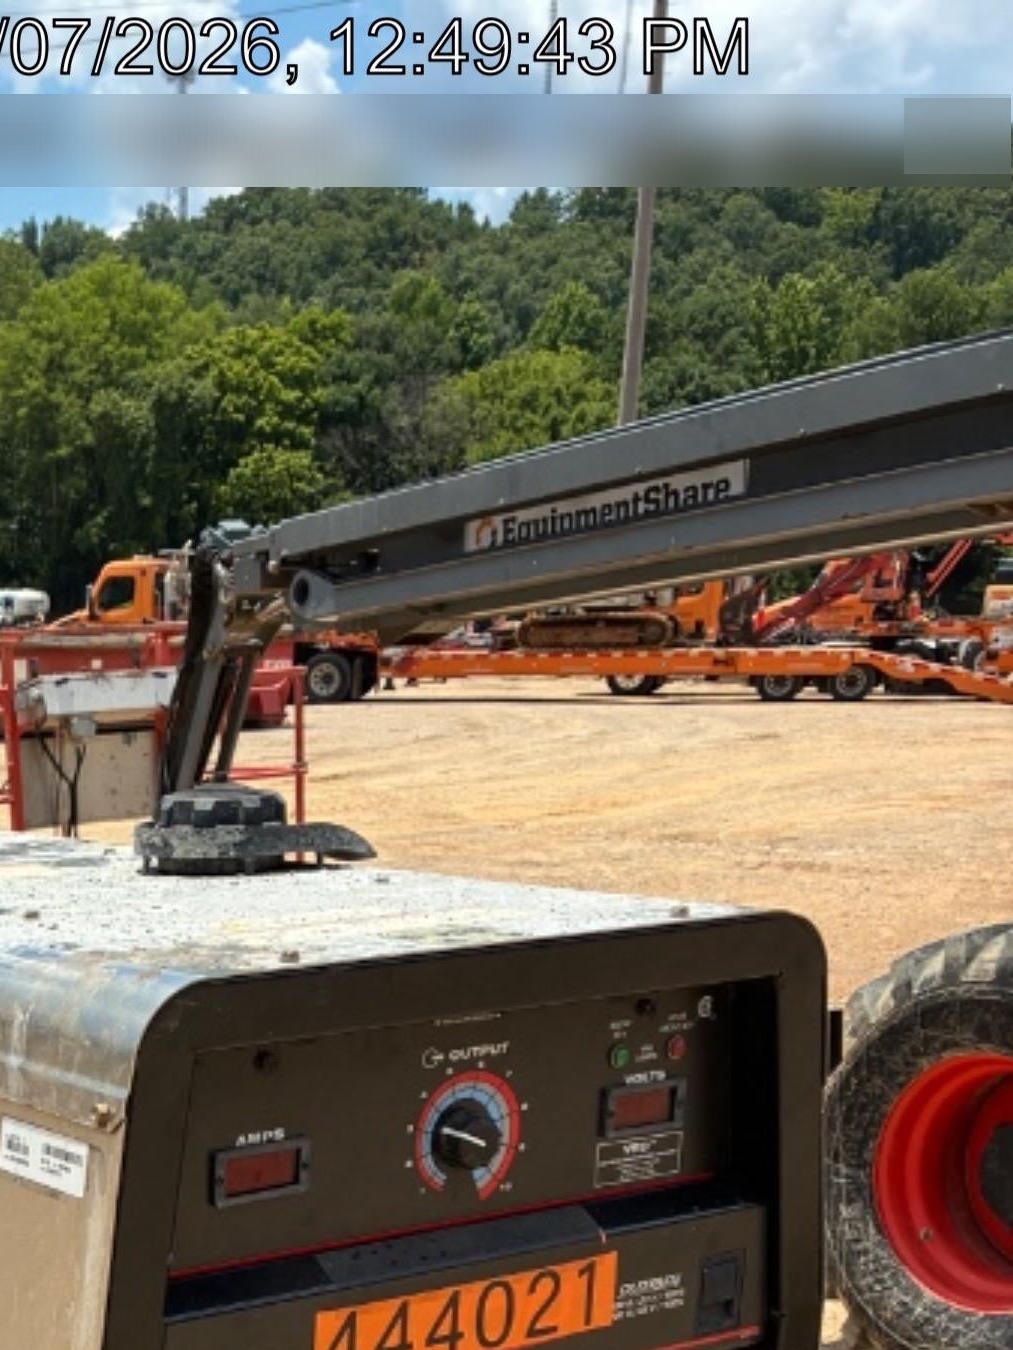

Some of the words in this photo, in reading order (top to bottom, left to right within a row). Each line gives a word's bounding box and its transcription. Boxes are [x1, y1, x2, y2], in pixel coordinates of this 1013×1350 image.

[501, 476, 732, 547] EquipmentShare
[448, 1041, 510, 1062] OUTPUT
[235, 1126, 286, 1147] AMPS
